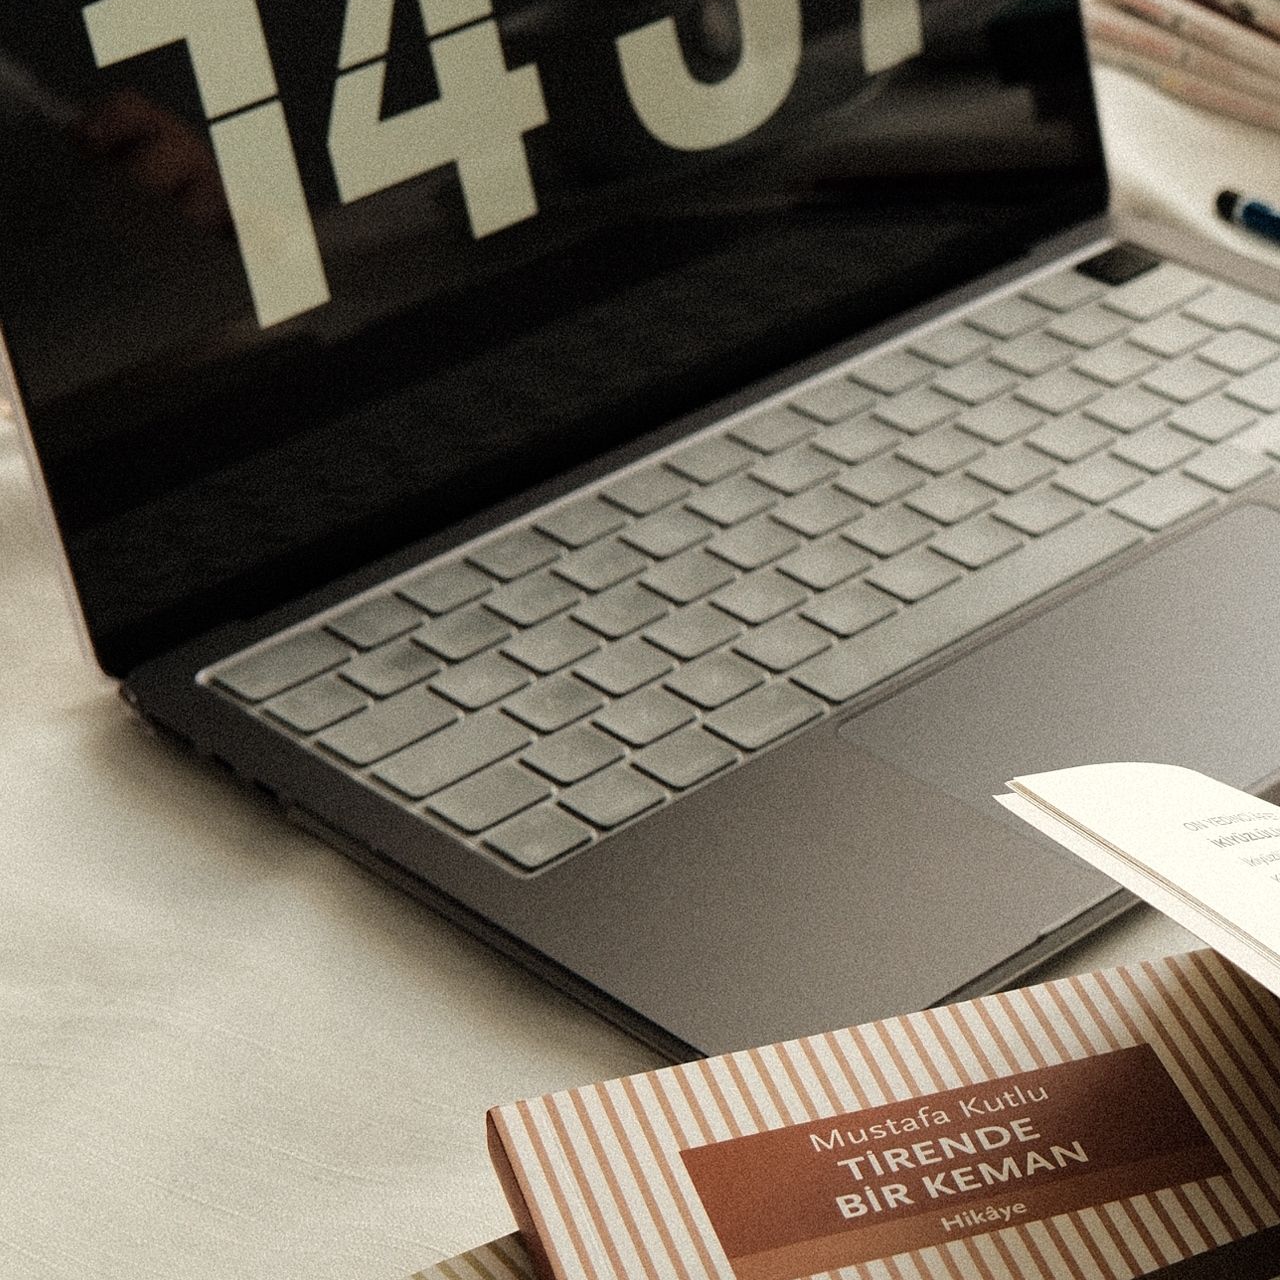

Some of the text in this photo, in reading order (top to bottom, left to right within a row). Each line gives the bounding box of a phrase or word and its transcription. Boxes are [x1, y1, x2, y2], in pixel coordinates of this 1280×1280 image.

[1182, 820, 1209, 832] ON
[809, 1082, 1050, 1153] Mustafa Kutlu
[837, 1116, 1042, 1182] TİRENDE
[836, 1140, 1090, 1220] BİR KEMAN
[941, 1199, 1028, 1233] Hikâye
